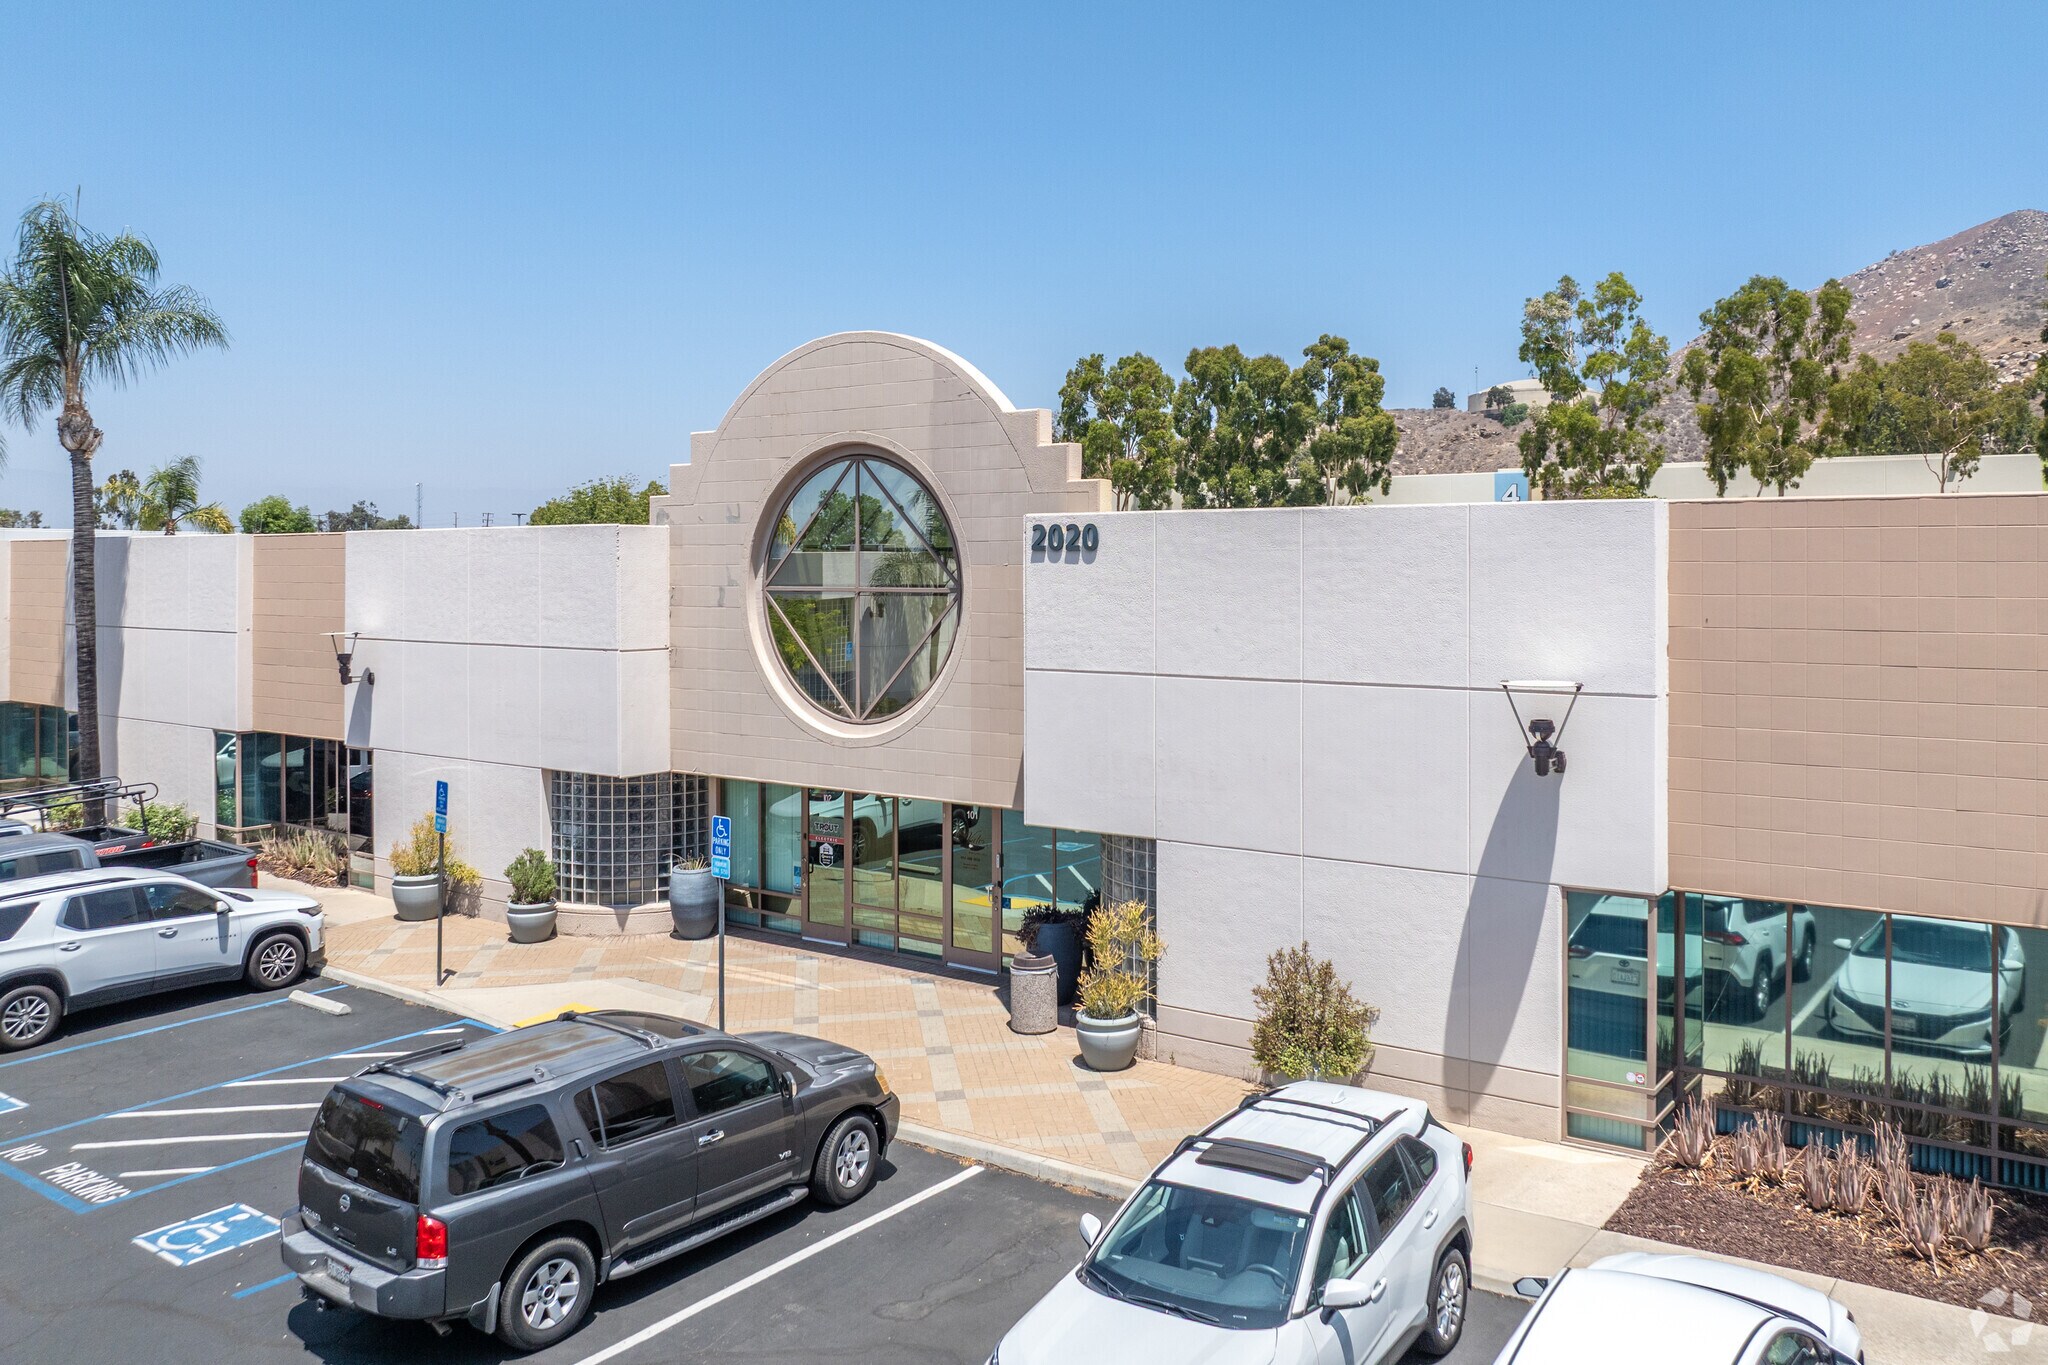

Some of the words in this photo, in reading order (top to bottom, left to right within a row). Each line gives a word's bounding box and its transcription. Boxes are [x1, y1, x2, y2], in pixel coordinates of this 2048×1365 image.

[1501, 483, 1520, 502] 4
[1031, 523, 1099, 552] 2020
[966, 810, 978, 820] 101
[814, 822, 839, 833] TROUT
[713, 836, 730, 847] PARKING
[715, 846, 727, 856] ONLY
[0, 1143, 49, 1162] NO
[39, 1161, 132, 1204] PARKING
